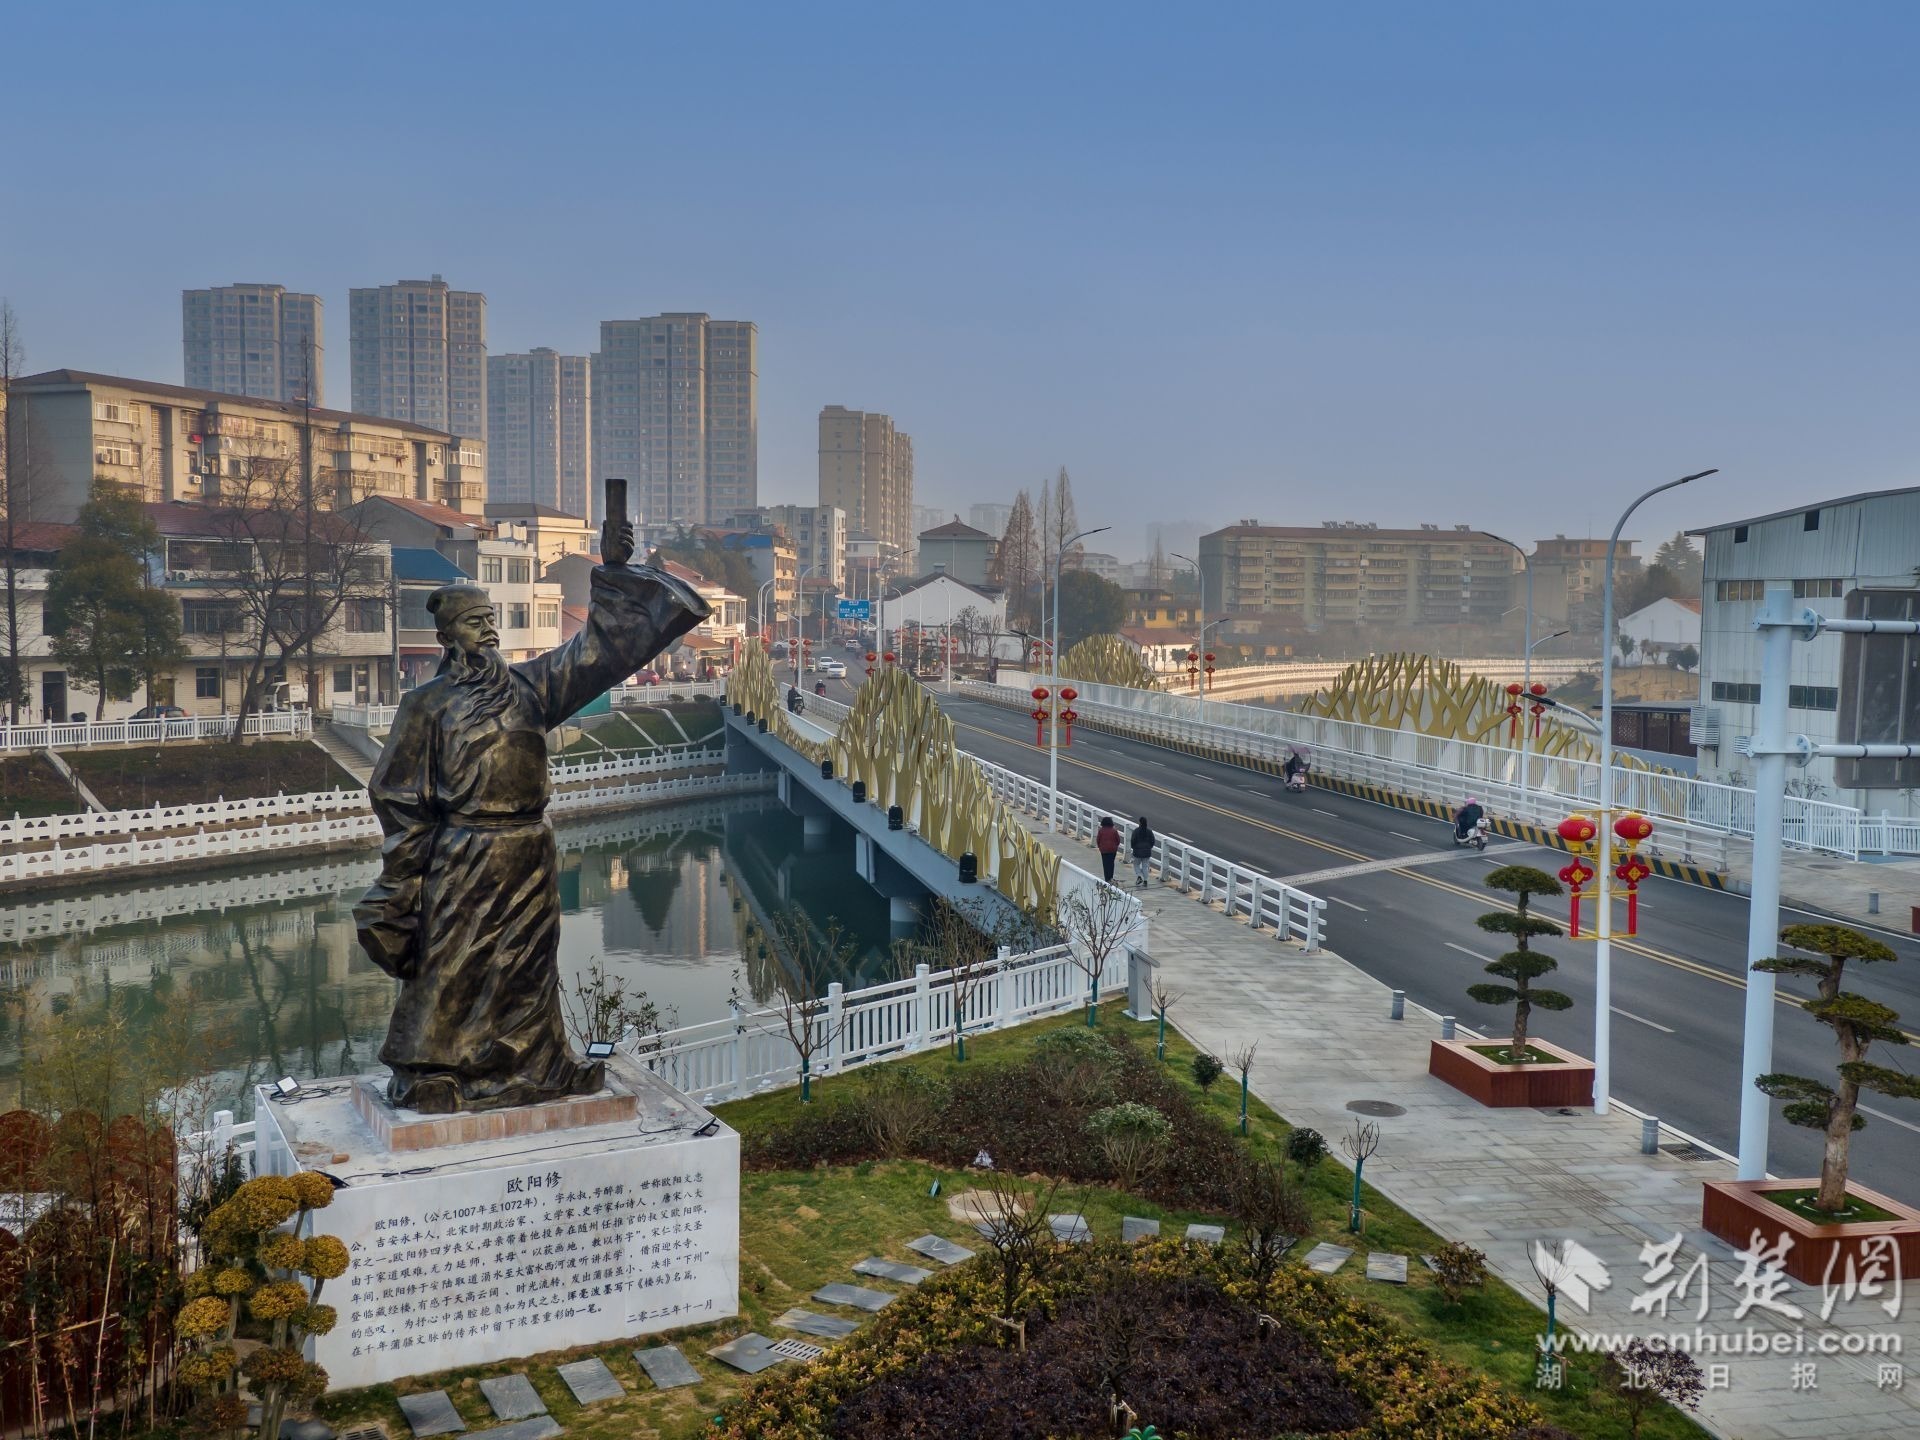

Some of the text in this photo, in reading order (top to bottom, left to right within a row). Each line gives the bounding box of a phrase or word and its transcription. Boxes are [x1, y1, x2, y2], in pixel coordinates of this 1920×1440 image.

[507, 1171, 562, 1195] 欧阳修
[626, 1298, 713, 1325] 二零二三年十一月
